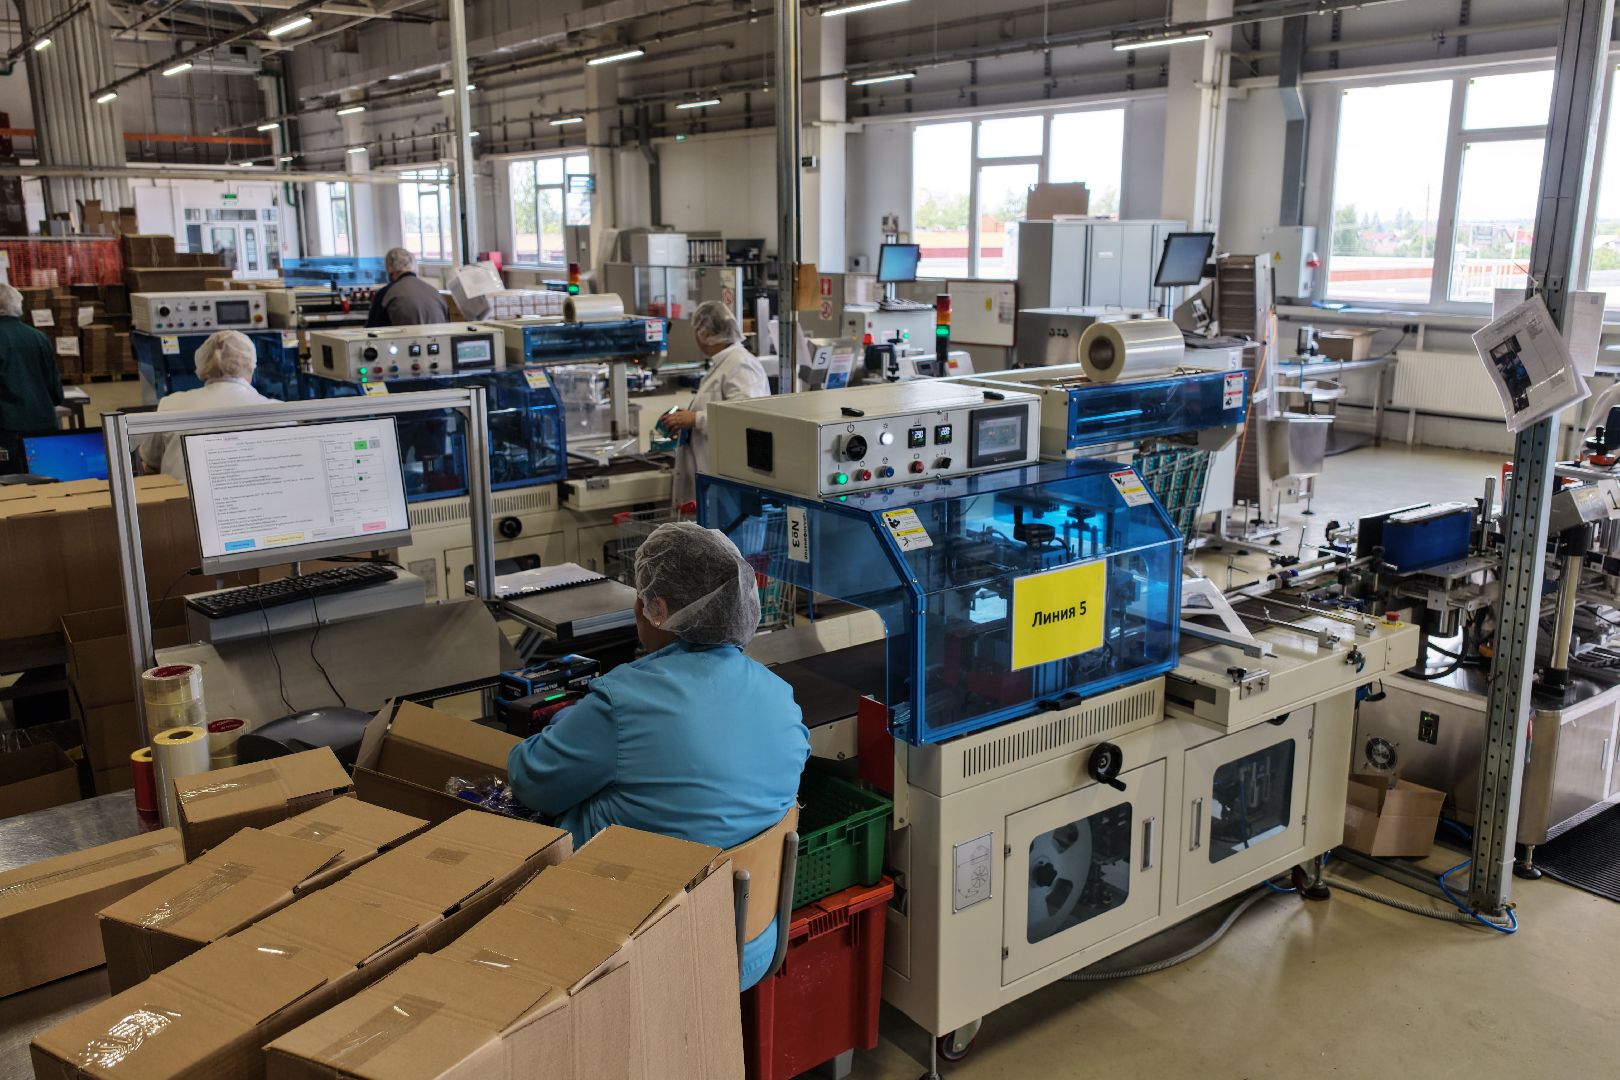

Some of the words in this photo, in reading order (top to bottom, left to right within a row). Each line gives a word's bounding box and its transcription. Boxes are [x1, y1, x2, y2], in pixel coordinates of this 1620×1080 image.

[817, 352, 827, 365] 5
[1031, 606, 1076, 628] Линия
[1079, 600, 1087, 616] 5
